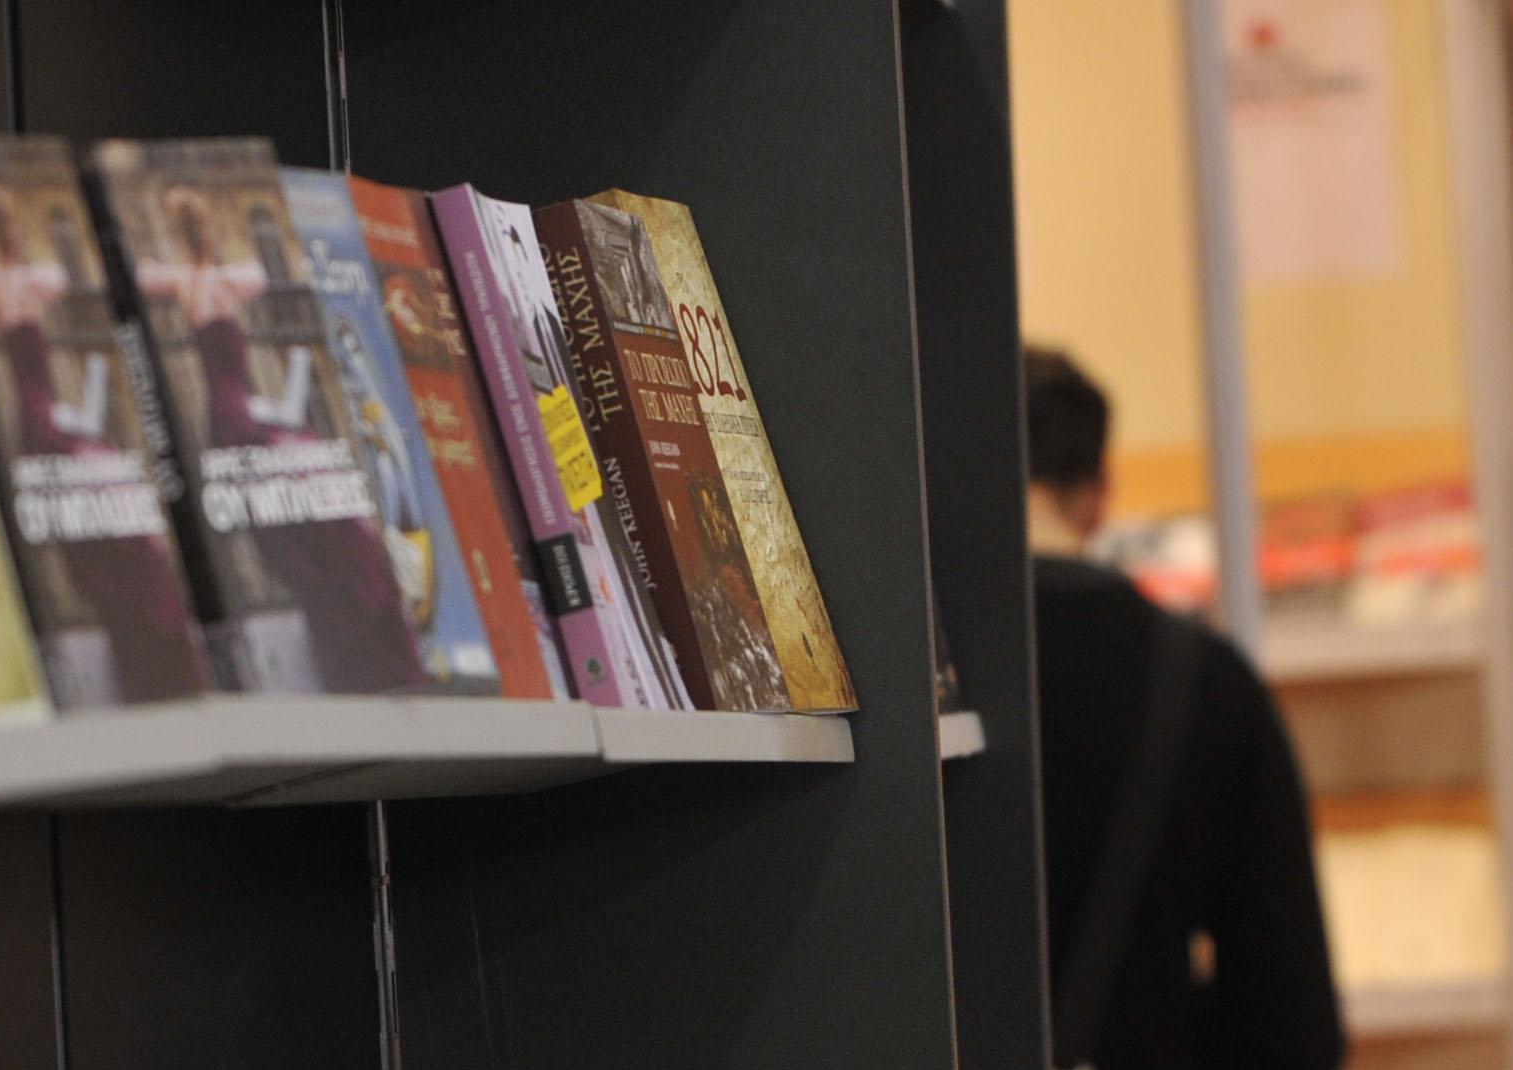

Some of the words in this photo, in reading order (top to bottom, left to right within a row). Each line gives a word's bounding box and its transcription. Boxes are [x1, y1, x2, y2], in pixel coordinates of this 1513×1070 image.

[557, 248, 605, 350] ΜΑΧΗΣ
[590, 361, 623, 421] ΤΗΣ
[676, 303, 748, 402] 821
[604, 457, 638, 548] KEEGAN
